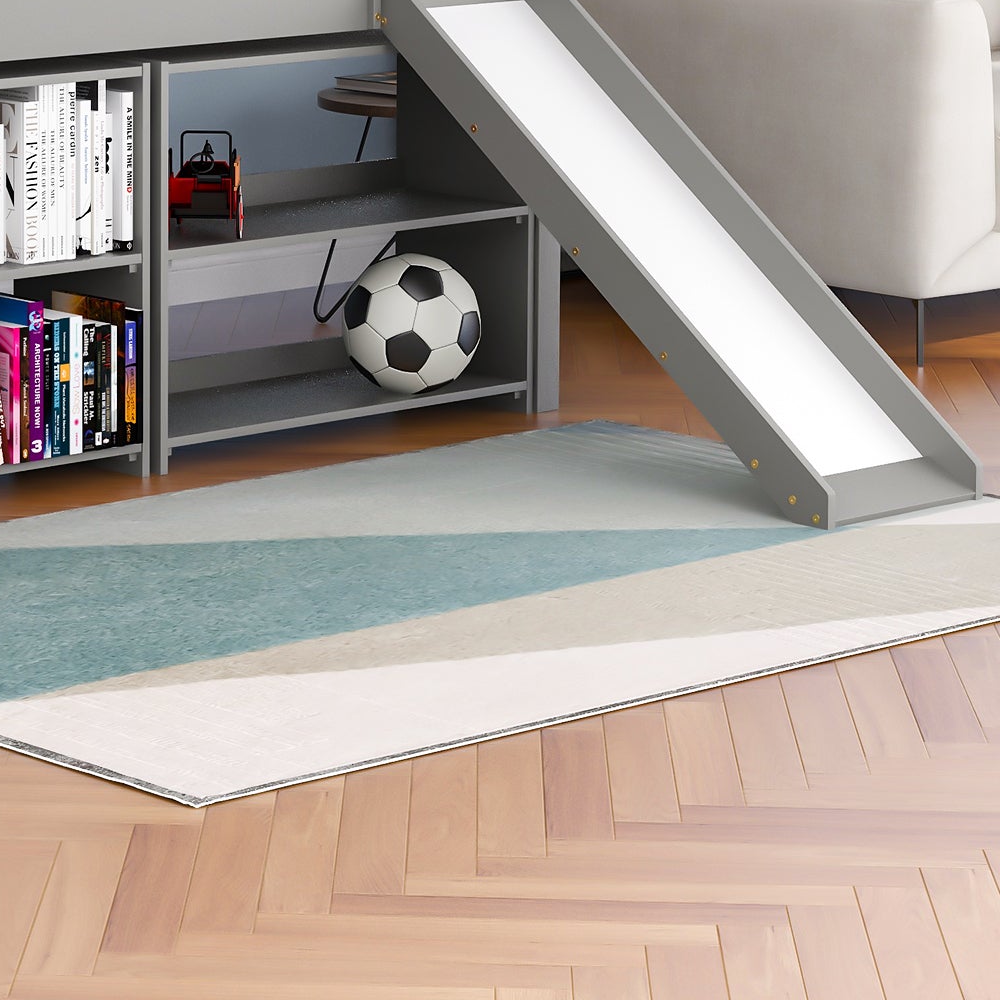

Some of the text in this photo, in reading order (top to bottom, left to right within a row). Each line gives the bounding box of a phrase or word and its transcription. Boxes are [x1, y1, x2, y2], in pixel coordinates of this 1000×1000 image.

[68, 91, 76, 122] pierre
[25, 103, 38, 139] THE
[59, 141, 65, 154] OF
[126, 142, 133, 152] IN
[25, 141, 38, 211] FASHION
[41, 178, 47, 188] OF
[50, 178, 55, 188] OF
[82, 328, 90, 357] Calling
[53, 352, 60, 363] ON
[88, 410, 94, 421] M.
[30, 439, 43, 454] 3
